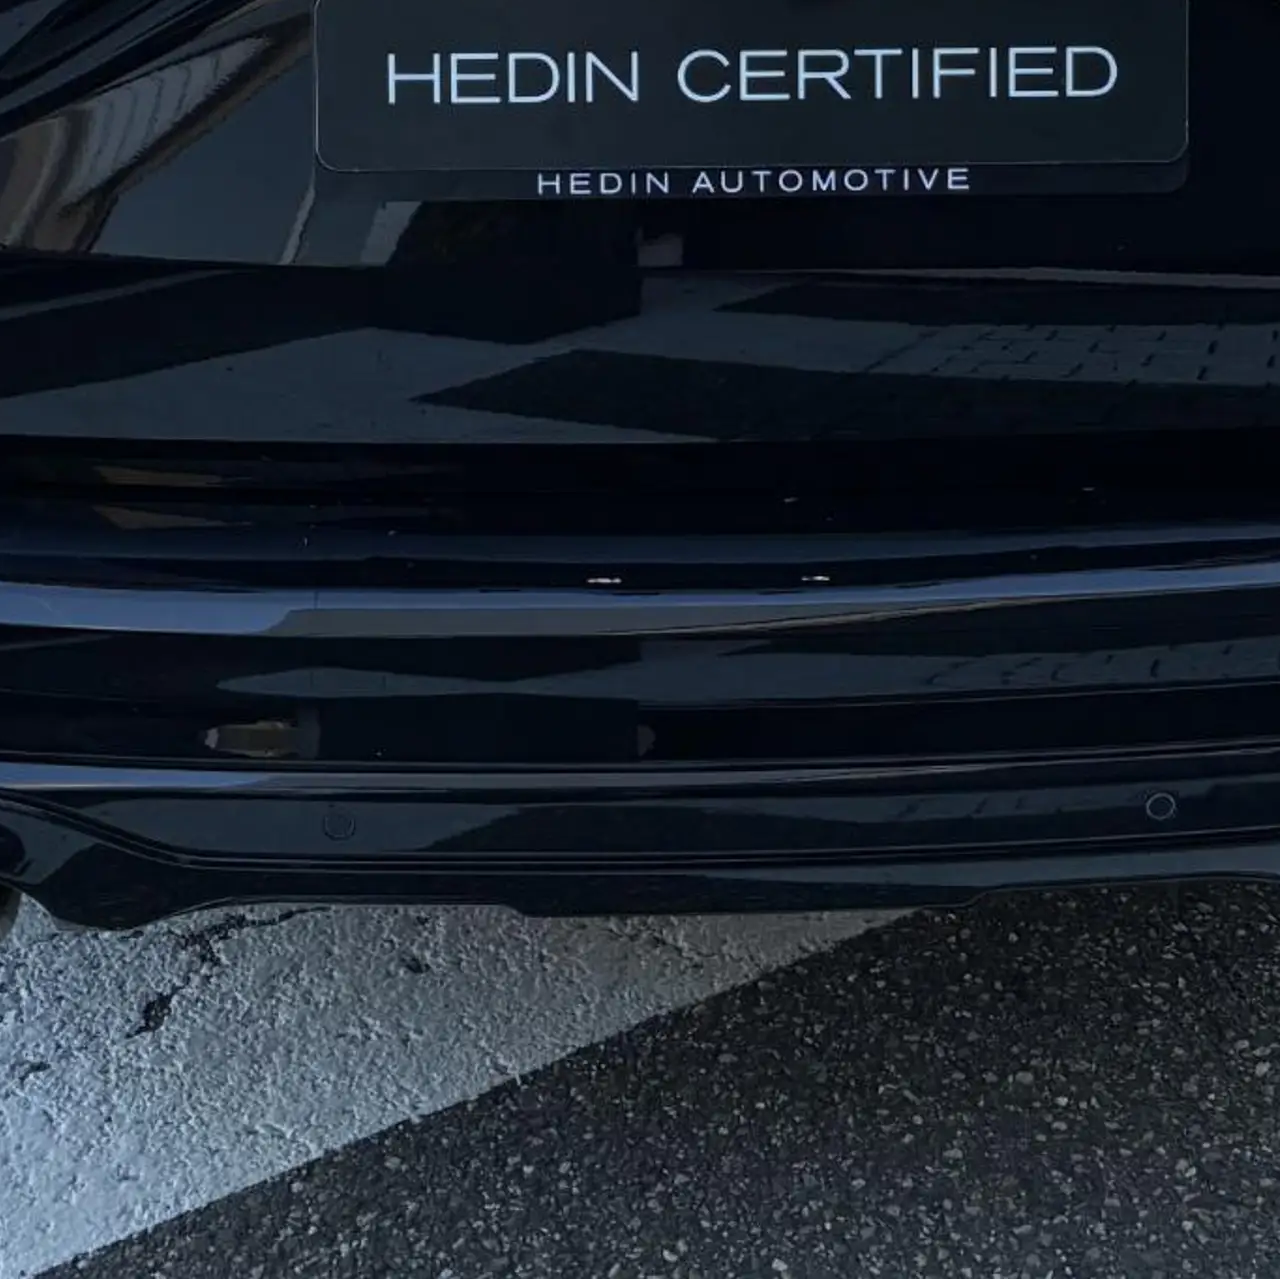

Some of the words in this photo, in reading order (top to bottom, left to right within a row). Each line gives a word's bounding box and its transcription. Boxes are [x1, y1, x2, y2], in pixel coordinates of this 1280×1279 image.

[388, 51, 639, 105] HEDIN
[677, 46, 1118, 103] CERTIFIED
[537, 172, 670, 195] HEDIN
[692, 167, 970, 194] AUTOMOTIVE
